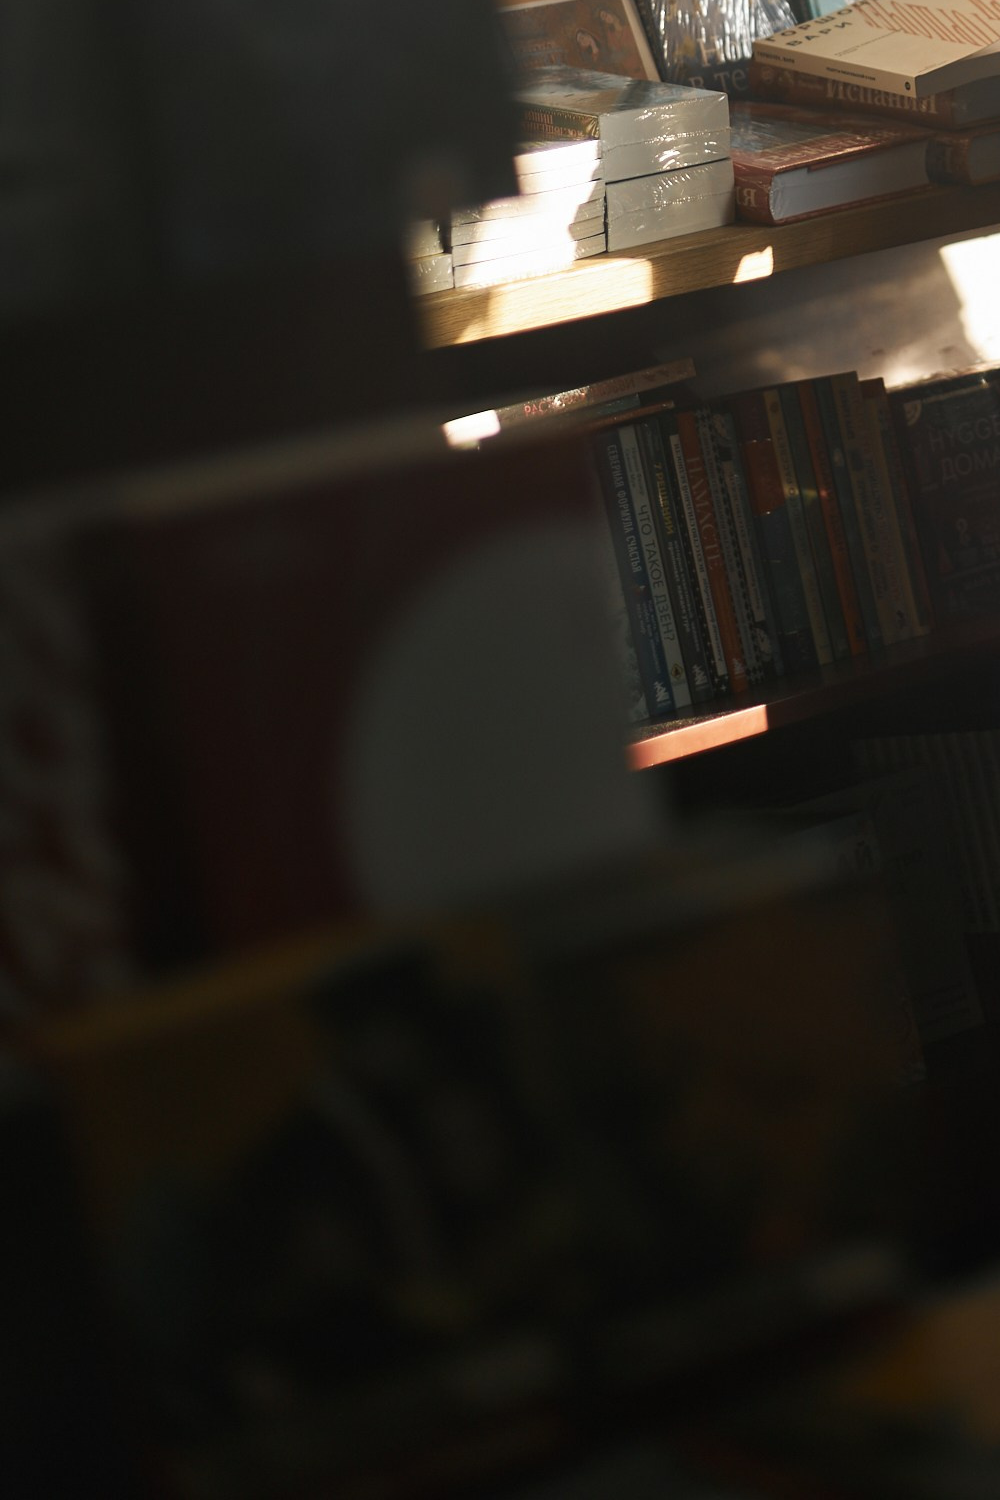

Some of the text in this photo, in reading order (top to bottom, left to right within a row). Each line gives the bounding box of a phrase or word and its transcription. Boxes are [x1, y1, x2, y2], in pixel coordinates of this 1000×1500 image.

[785, 20, 854, 47] ВАРИ
[607, 443, 643, 574] СЕВЕРНАЯ ФОРМУЛА СЧАСТЬЯ
[638, 504, 676, 642] ЧТО ТАКОЕ ДЗЕН?
